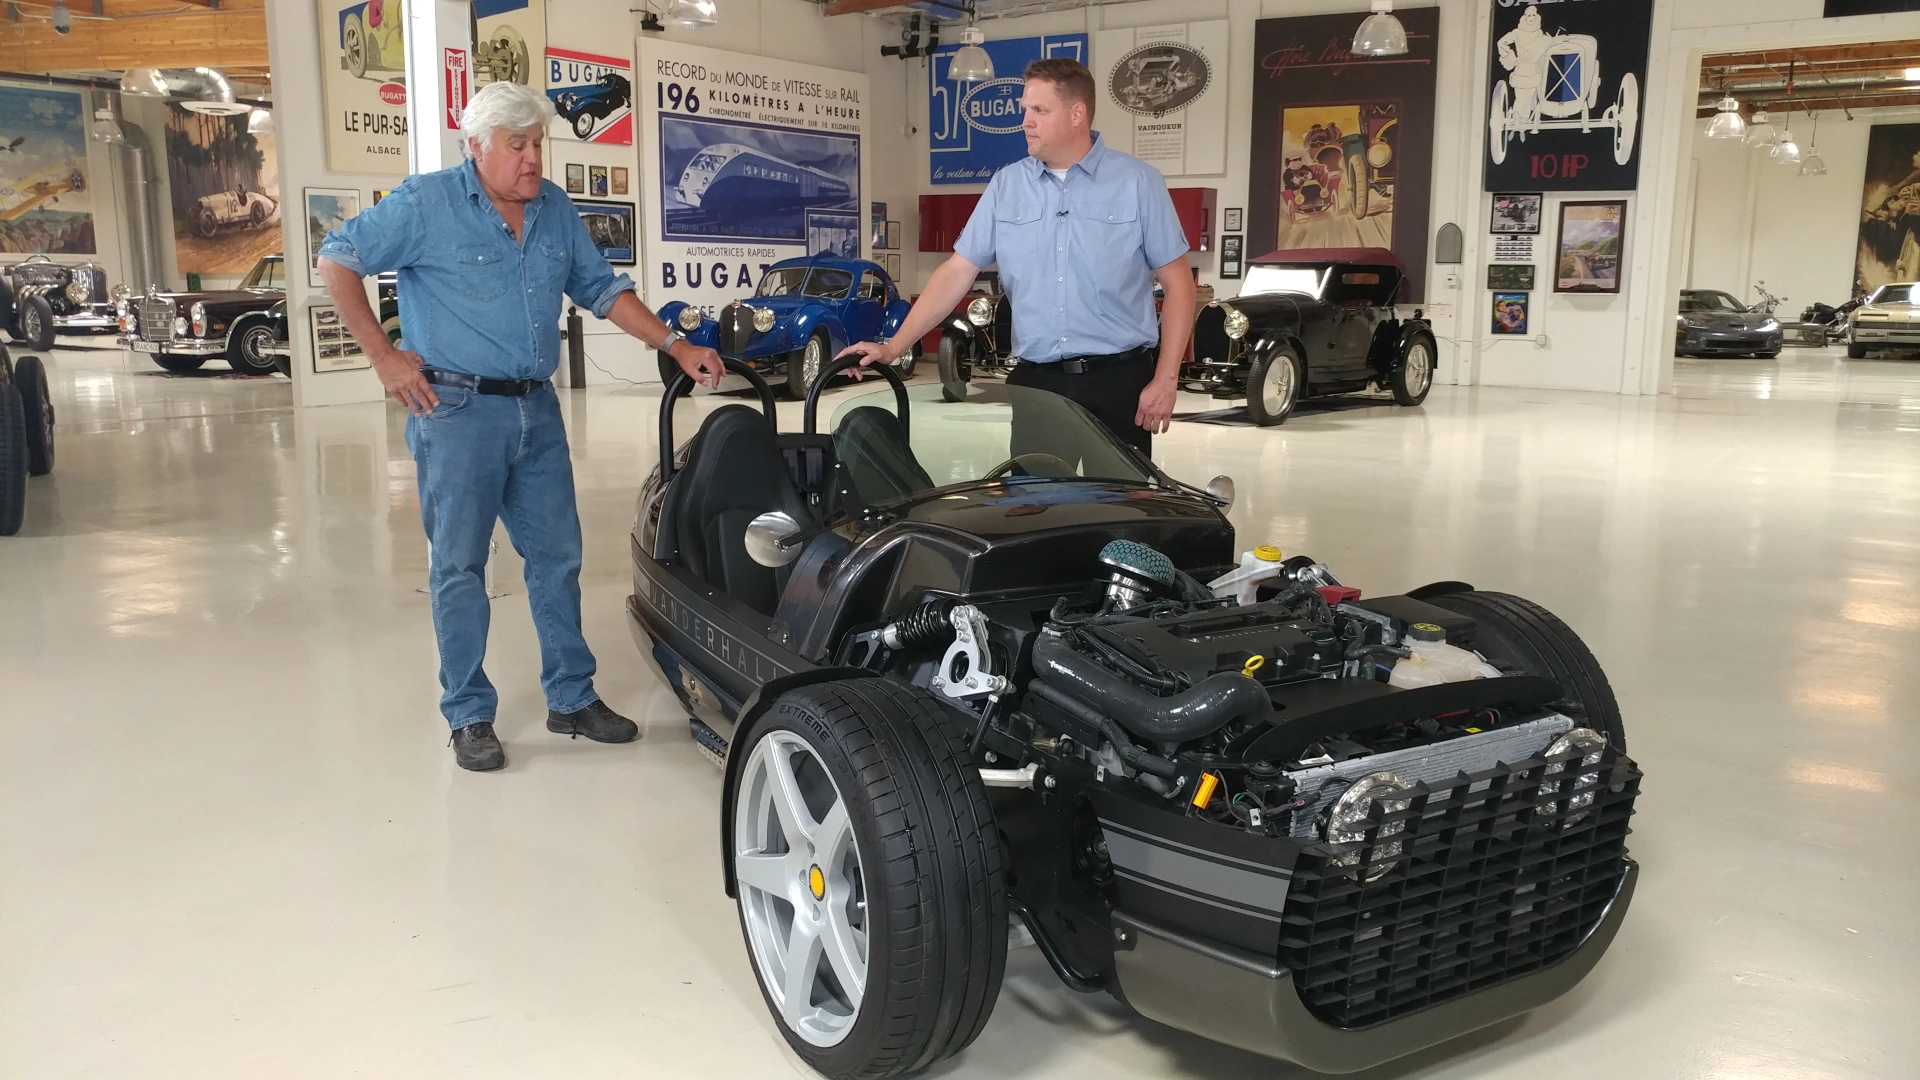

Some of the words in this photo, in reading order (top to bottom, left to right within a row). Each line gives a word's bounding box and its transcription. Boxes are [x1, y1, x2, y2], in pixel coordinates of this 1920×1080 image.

[448, 55, 463, 67] FIRE
[657, 59, 707, 81] RECORD
[710, 72, 722, 84] DU
[725, 70, 768, 90] MONDE
[771, 81, 781, 92] DE
[783, 78, 822, 98] VITESSE
[825, 89, 838, 100] SUR
[840, 87, 860, 104] RAIL
[380, 91, 407, 101] BUGATT
[657, 81, 700, 113] 196
[709, 89, 789, 111] KILOMÈTRES
[798, 102, 805, 113] A
[815, 104, 860, 120] L'HEURE
[971, 98, 1023, 118] BUGAT
[344, 110, 359, 132] LE
[363, 112, 409, 136] PUR-SA
[807, 119, 818, 128] SUR
[1137, 123, 1182, 131] VAINQUEUR
[366, 145, 402, 156] ALSACE
[933, 165, 944, 179] la
[946, 167, 975, 179] voiture
[976, 165, 992, 178] des
[1530, 154, 1558, 179] 10
[1561, 154, 1589, 178] HP
[686, 246, 745, 257] AUTOMOTRICES
[747, 248, 776, 258] RAPIDES
[662, 262, 771, 289] BUGAT
[779, 704, 831, 742] EXTREME
